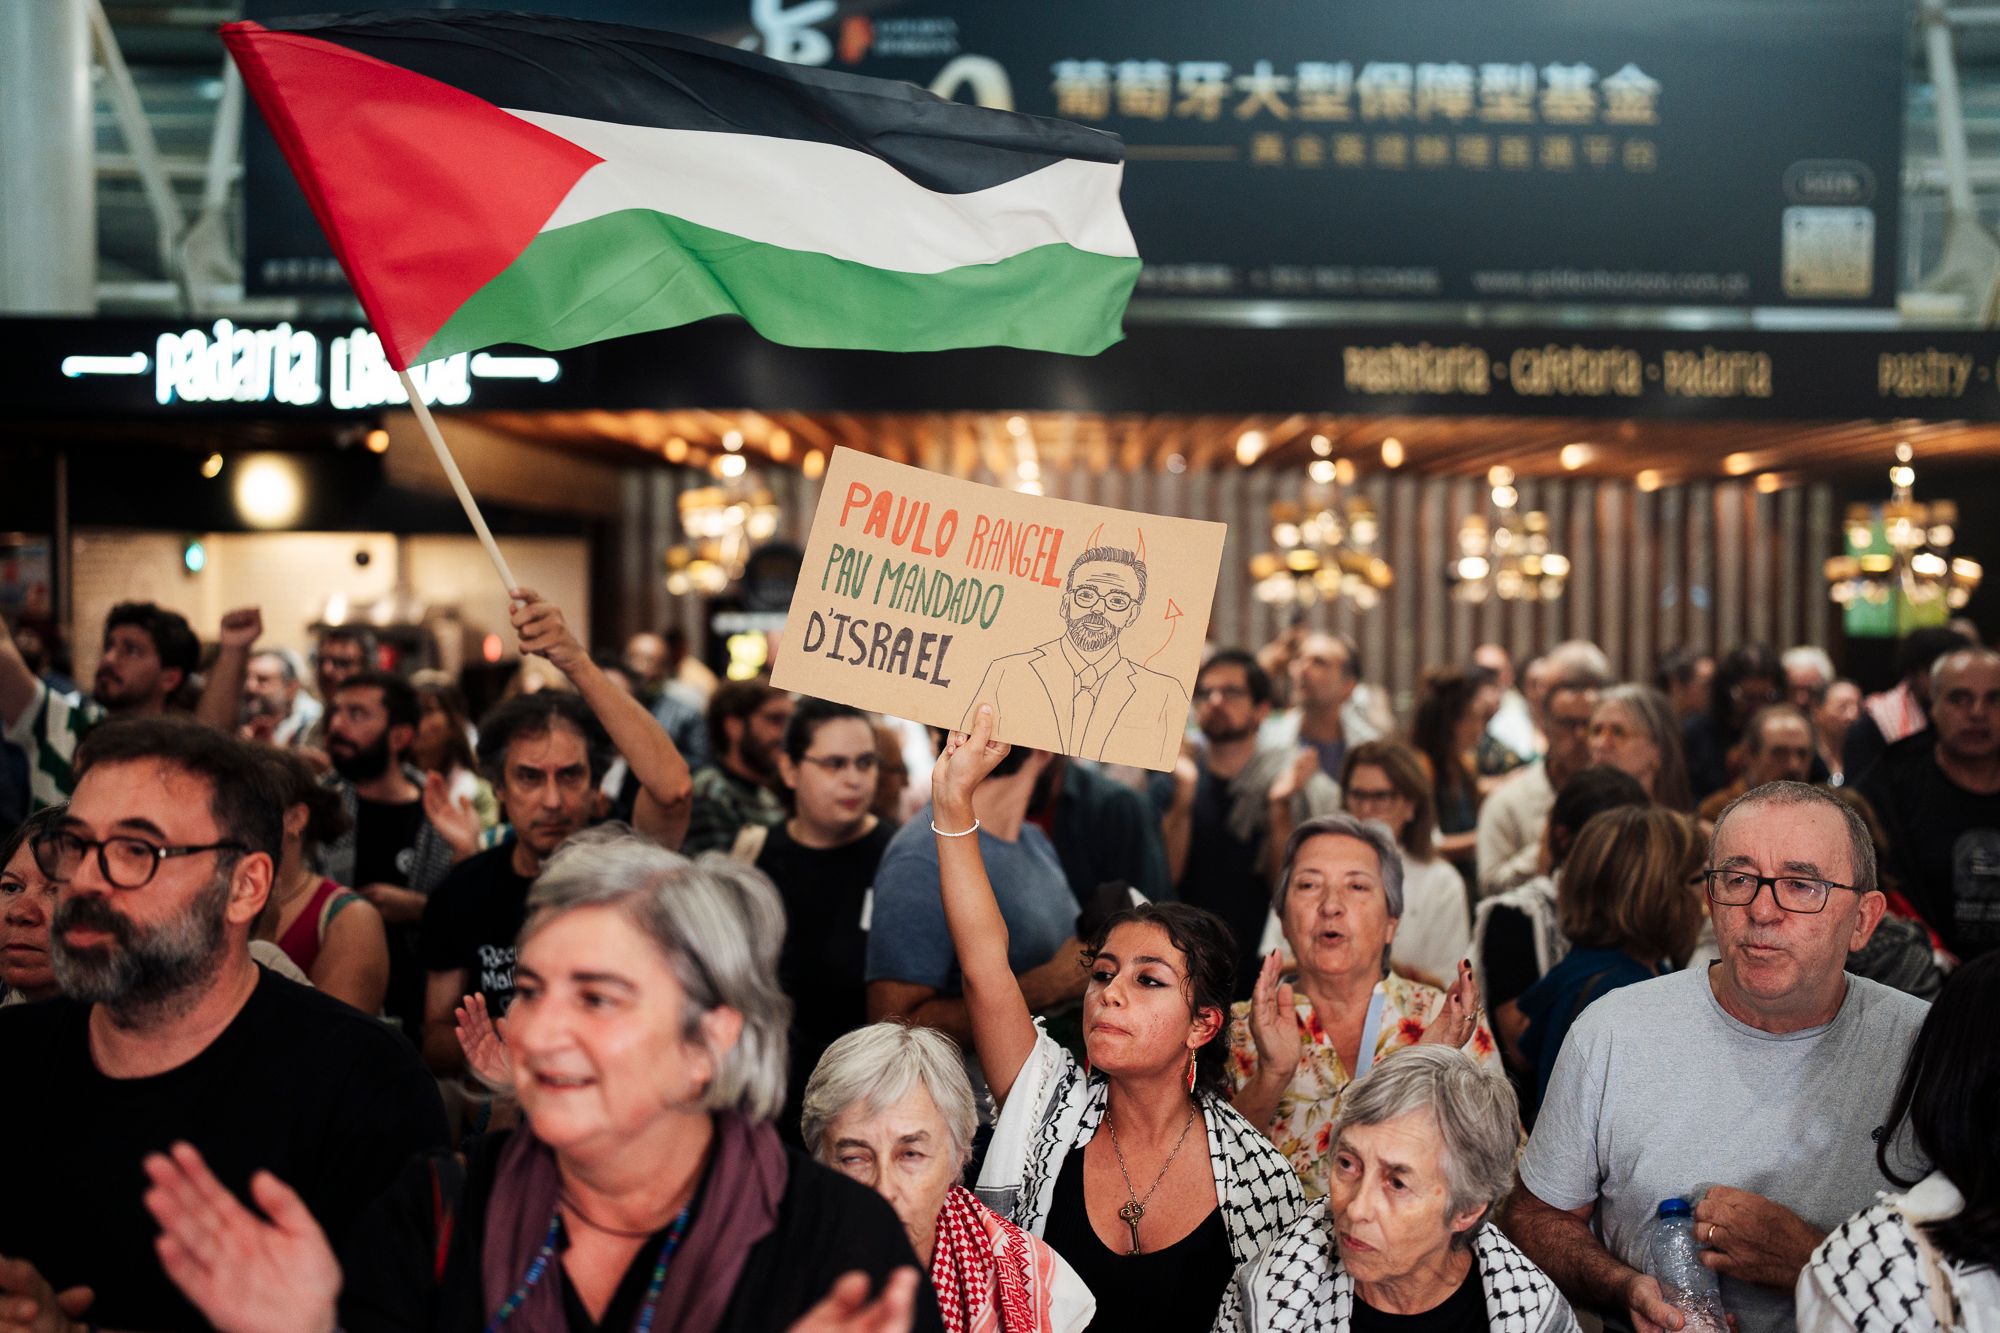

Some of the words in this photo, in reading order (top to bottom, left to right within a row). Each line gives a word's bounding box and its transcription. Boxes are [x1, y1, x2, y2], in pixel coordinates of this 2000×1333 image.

[1050, 58, 1662, 125] 葡萄牙大型保障型基金
[840, 481, 959, 558] PAULO
[965, 514, 1065, 588] RANGEL
[821, 543, 873, 600] PAU
[873, 558, 1005, 630] MANDADO
[803, 608, 953, 688] D'ISRAEL
